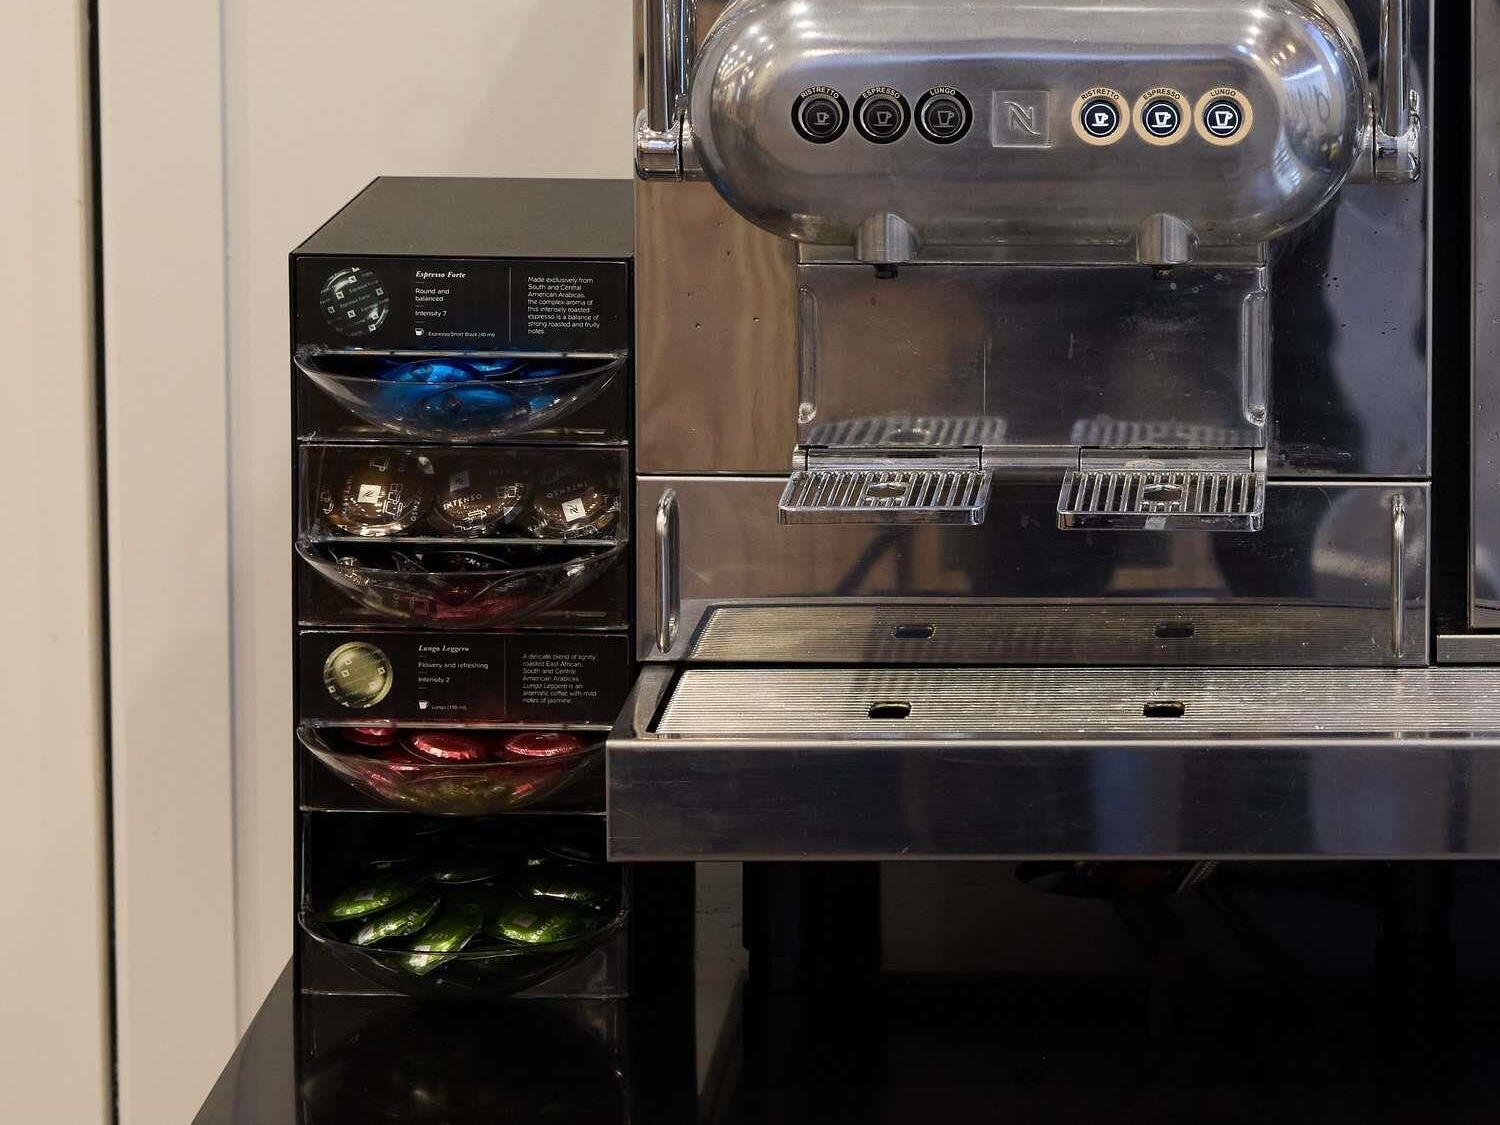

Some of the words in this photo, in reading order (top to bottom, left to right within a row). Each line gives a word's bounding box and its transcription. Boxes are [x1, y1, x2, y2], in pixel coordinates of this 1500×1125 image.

[800, 86, 839, 99] RISTRETTO
[862, 87, 901, 99] ESPRESSO
[929, 86, 956, 96] LUNGO
[1080, 88, 1120, 101] RISTRETTO
[1142, 88, 1181, 101] ESPRESSO
[1210, 89, 1237, 97] LUNGO
[415, 270, 445, 279] Espresso
